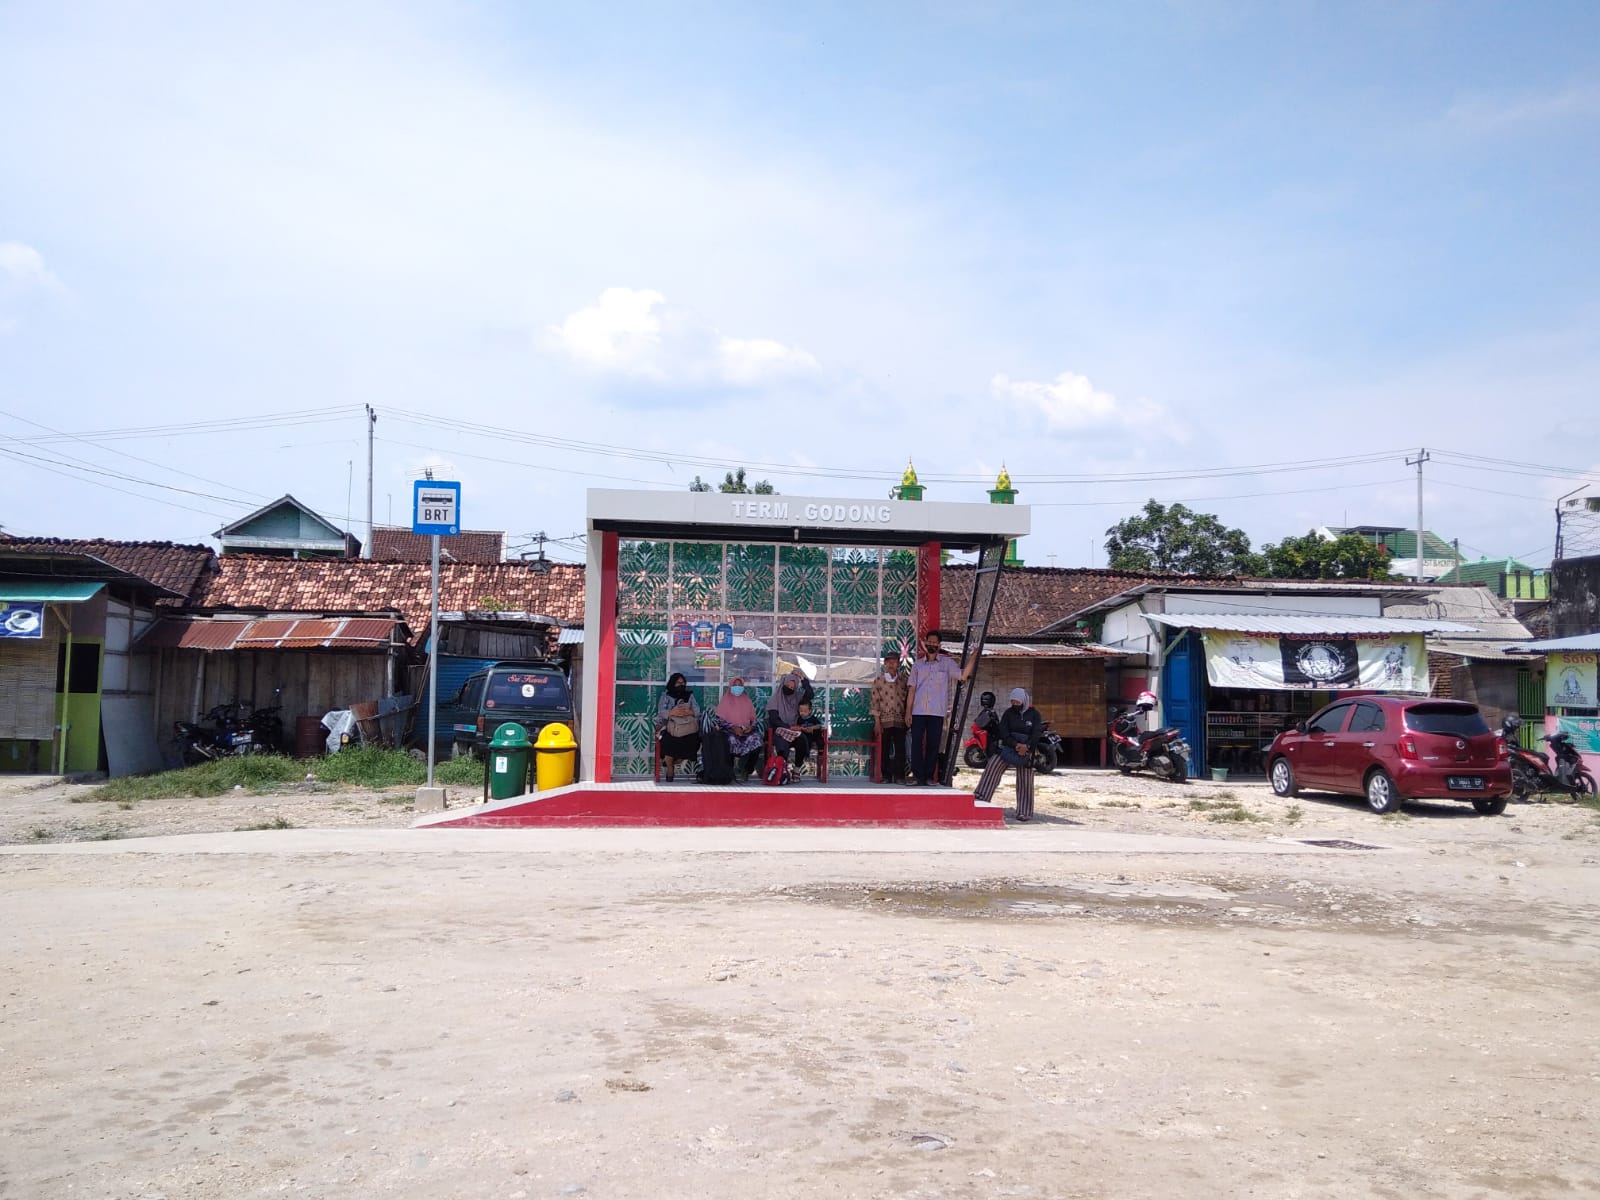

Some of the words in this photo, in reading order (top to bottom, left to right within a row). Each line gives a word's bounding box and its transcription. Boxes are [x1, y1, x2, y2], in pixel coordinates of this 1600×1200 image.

[424, 508, 449, 521] BRT
[732, 501, 789, 520] TERM
[805, 503, 891, 522] GODONG
